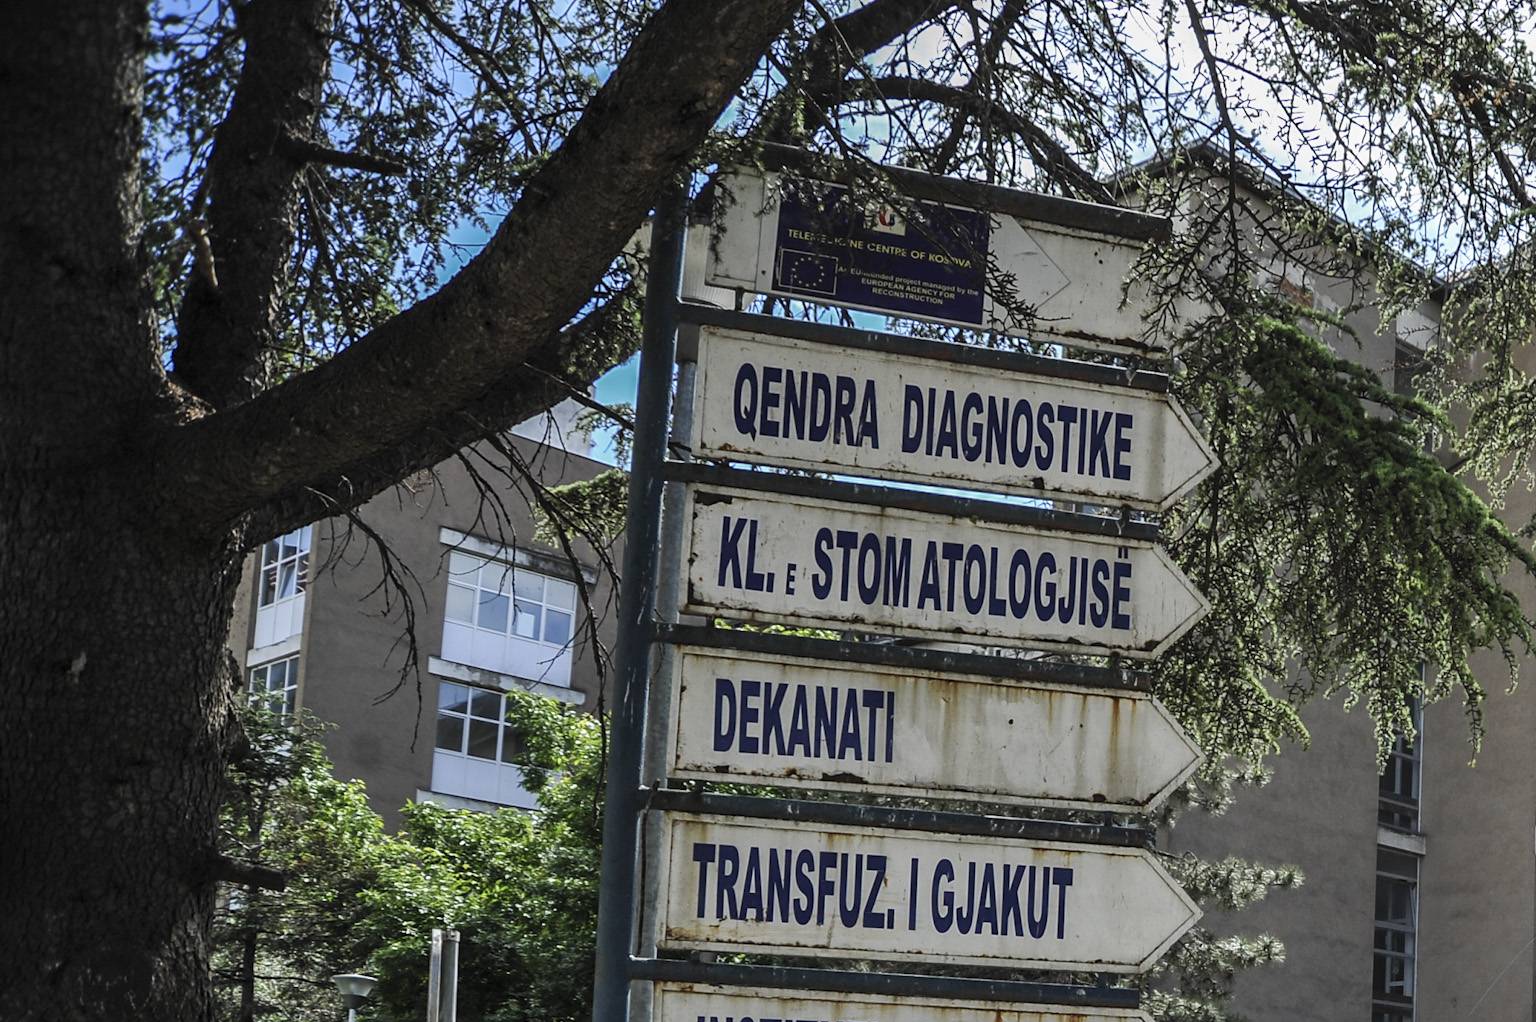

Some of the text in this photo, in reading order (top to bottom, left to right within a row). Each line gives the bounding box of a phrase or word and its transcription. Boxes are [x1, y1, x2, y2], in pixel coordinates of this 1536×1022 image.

[910, 250, 926, 260] OF
[861, 277, 955, 300] EUROPEAN AGENCY FOR
[872, 287, 943, 305] RECONSTRUCTION
[895, 275, 921, 288] project
[921, 280, 956, 294] managed
[957, 286, 966, 295] by
[967, 288, 979, 297] the
[734, 362, 1133, 481] QENDRA DIAGNOSTIKE
[718, 516, 775, 593] KL.
[785, 563, 796, 595] E
[713, 678, 895, 763] DEKANATI
[693, 843, 1074, 940] TRANSFUZ. I GJAKUT
